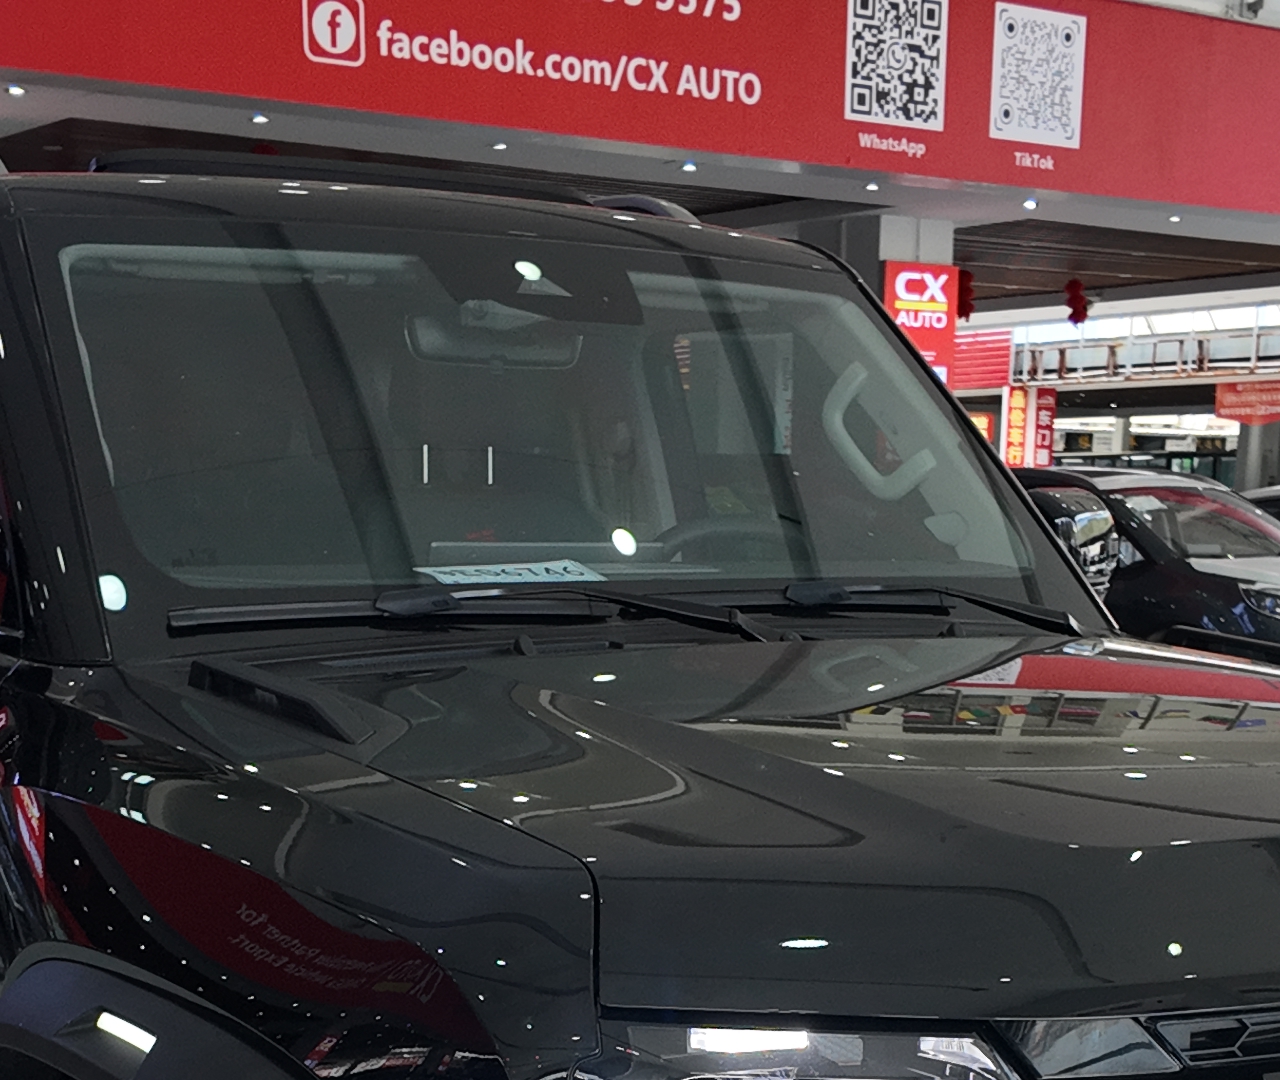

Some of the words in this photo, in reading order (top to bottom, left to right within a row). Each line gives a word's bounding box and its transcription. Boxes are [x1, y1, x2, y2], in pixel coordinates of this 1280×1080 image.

[377, 19, 669, 93] facebook.com/CX
[676, 64, 762, 105] AUTO
[858, 132, 926, 158] WhatsApp
[1013, 152, 1055, 170] TikTok
[895, 271, 949, 302] CX
[896, 310, 948, 328] AUTO
